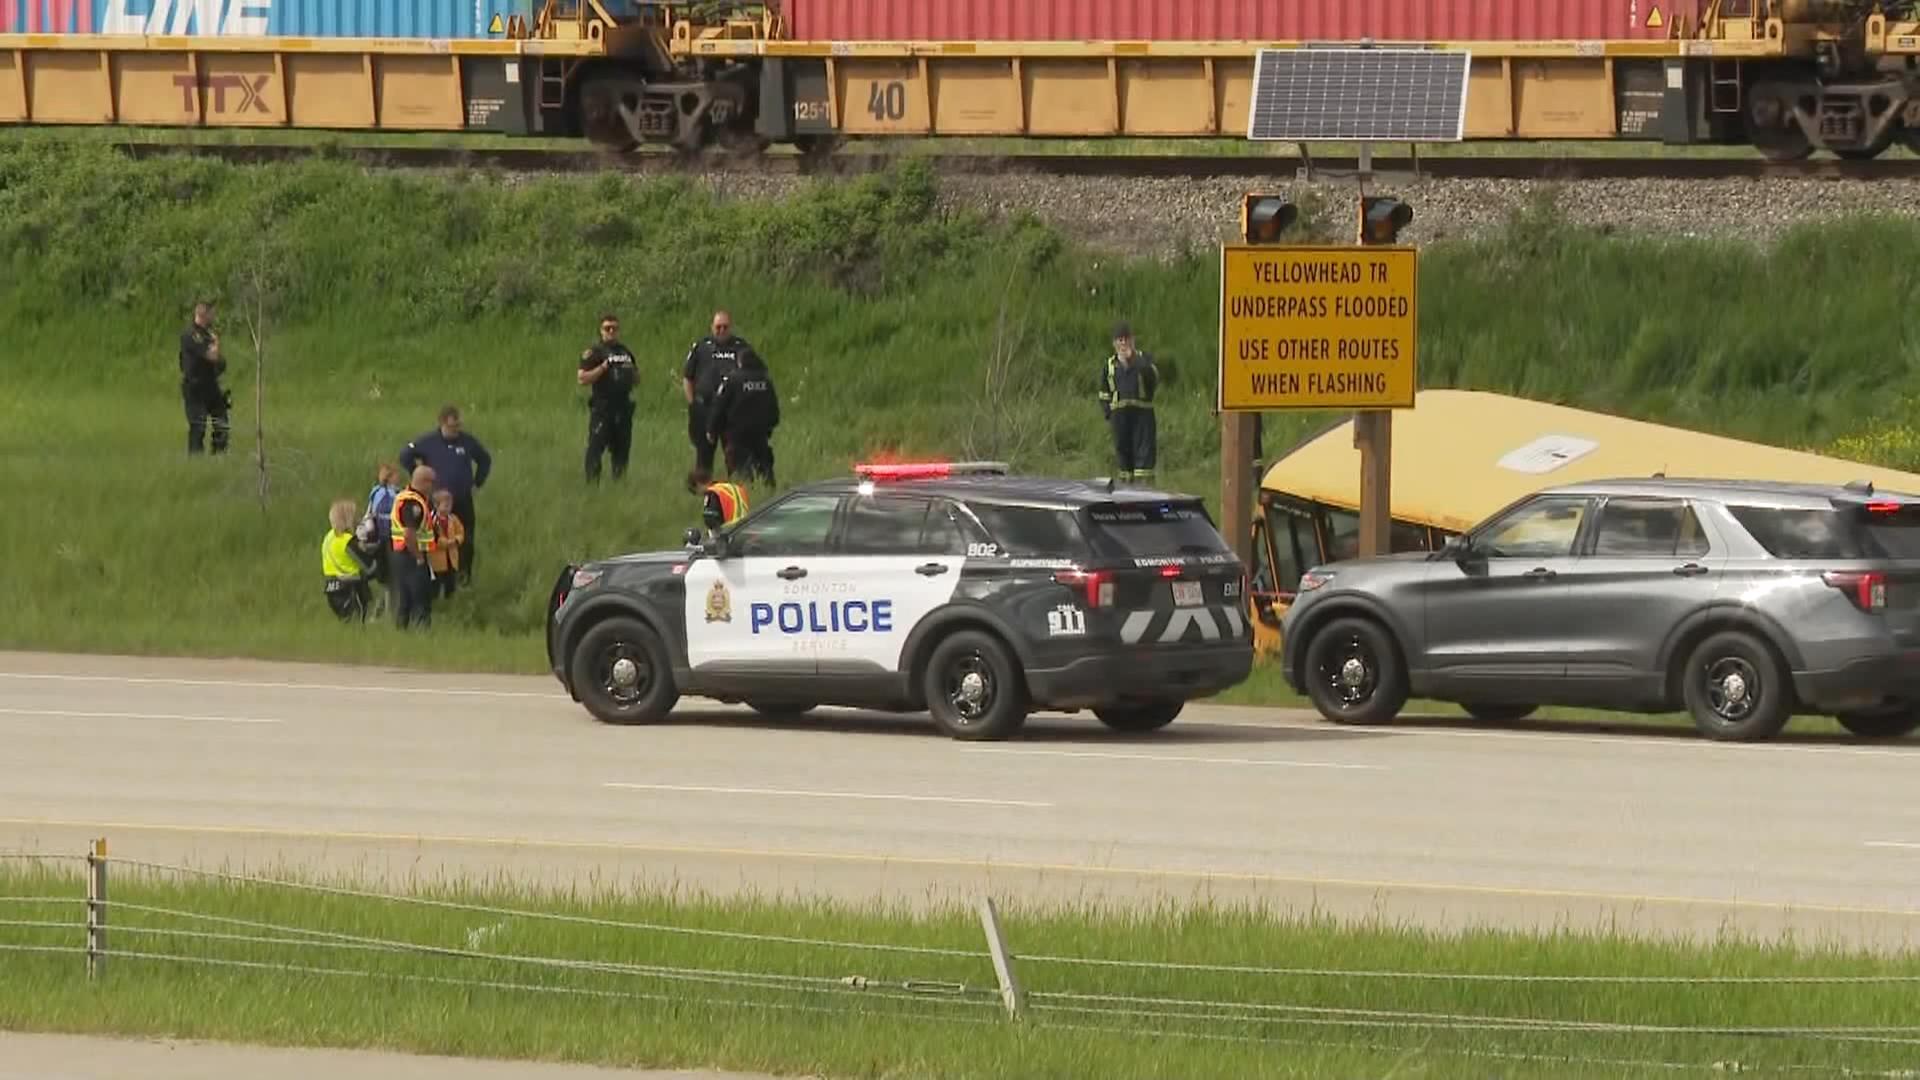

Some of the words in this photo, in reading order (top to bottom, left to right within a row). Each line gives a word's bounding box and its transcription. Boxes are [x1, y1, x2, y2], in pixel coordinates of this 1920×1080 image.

[173, 74, 271, 113] TTX
[867, 81, 905, 121] 40
[1254, 262, 1361, 283] YELLOWHEAD
[1370, 262, 1388, 283] TR
[1231, 296, 1327, 318] UNDERPASS
[1336, 295, 1408, 318] FLOODED
[1239, 338, 1269, 360] USE
[1278, 338, 1330, 360] OTHER
[1338, 338, 1399, 360] ROUTES
[1251, 373, 1300, 395] WHEN
[1309, 373, 1386, 394] FLASHING
[783, 583, 857, 594] EDMONTON
[751, 600, 892, 634] POLICE
[1048, 611, 1085, 636] 911
[793, 639, 847, 652] SERVICE
